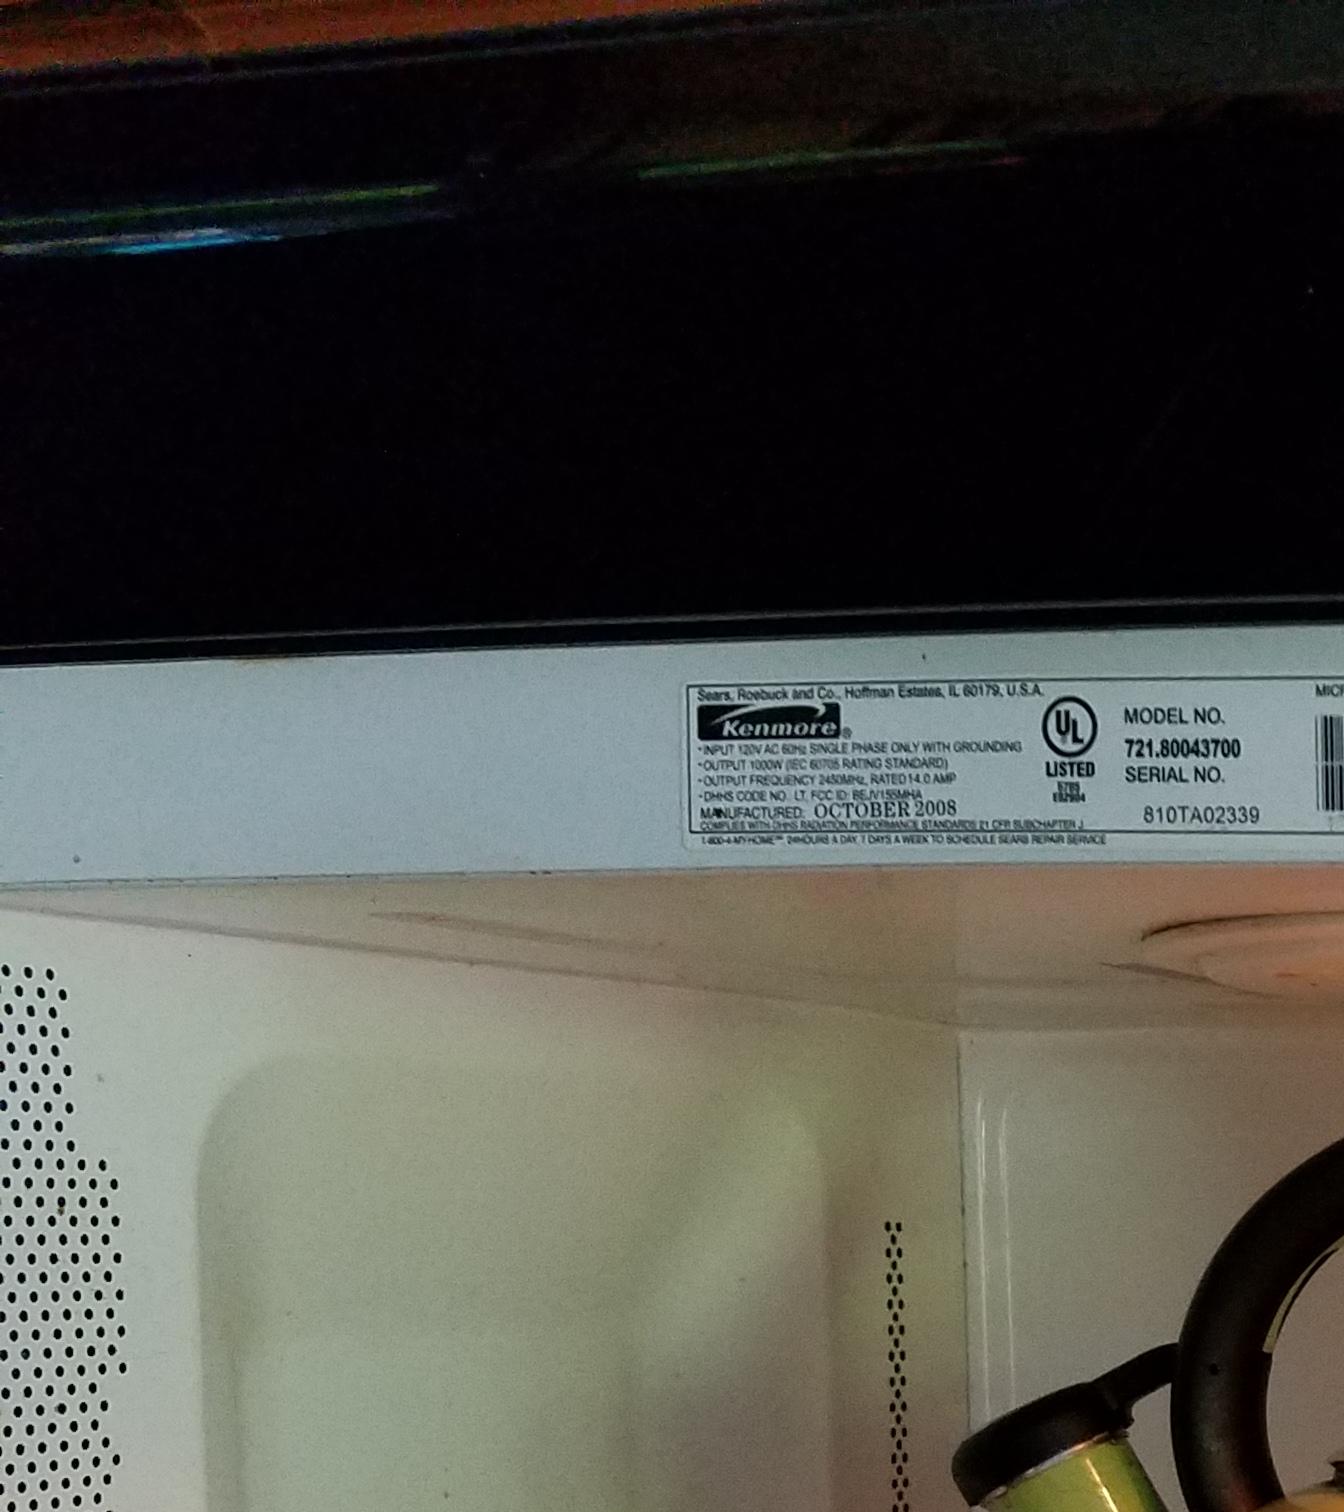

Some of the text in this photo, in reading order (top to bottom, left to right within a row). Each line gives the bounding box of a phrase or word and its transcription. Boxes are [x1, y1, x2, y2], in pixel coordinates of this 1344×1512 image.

[1124, 707, 1225, 724] MODEL NO.
[722, 720, 837, 737] Kenmore
[891, 741, 922, 752] ONLY
[923, 741, 950, 752] WITH
[1125, 738, 1241, 758] 721.80043700
[1046, 762, 1095, 777] LISTED
[1125, 766, 1225, 783] SERIAL NO.
[814, 800, 957, 819] OCTOBER 2008
[1144, 806, 1259, 824] 810TA02339
